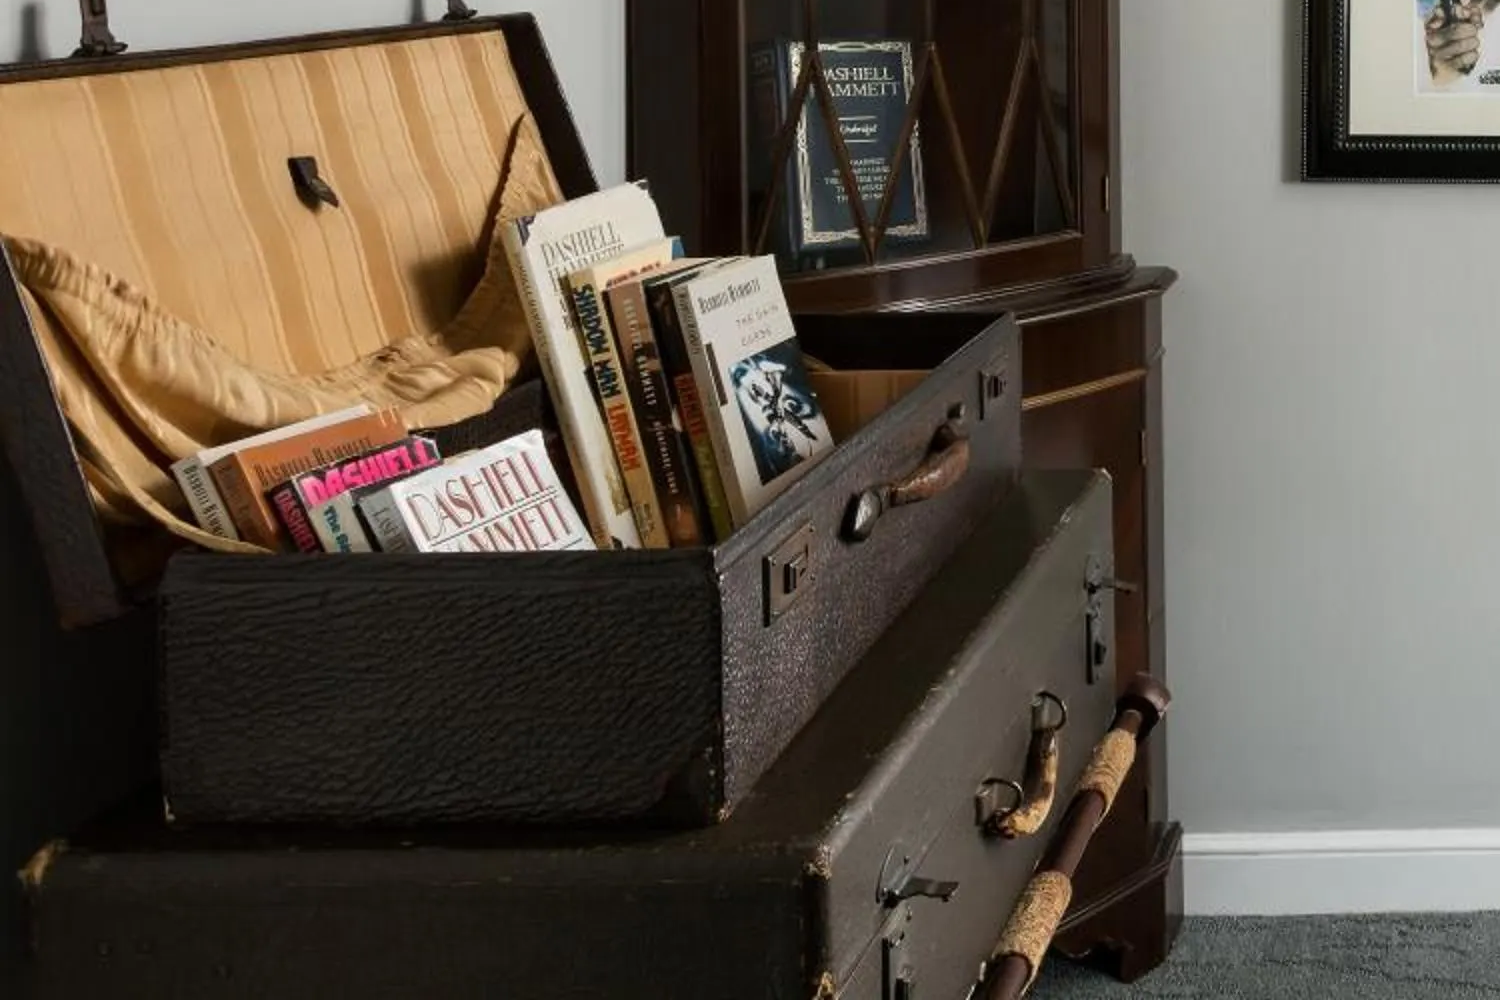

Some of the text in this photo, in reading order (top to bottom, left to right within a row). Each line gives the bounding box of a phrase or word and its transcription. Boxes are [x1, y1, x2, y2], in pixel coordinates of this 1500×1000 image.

[822, 67, 896, 82] ASHIELL
[593, 357, 622, 399] MAN
[301, 439, 437, 506] DASHIELL
[407, 450, 557, 542] DASHIELL
